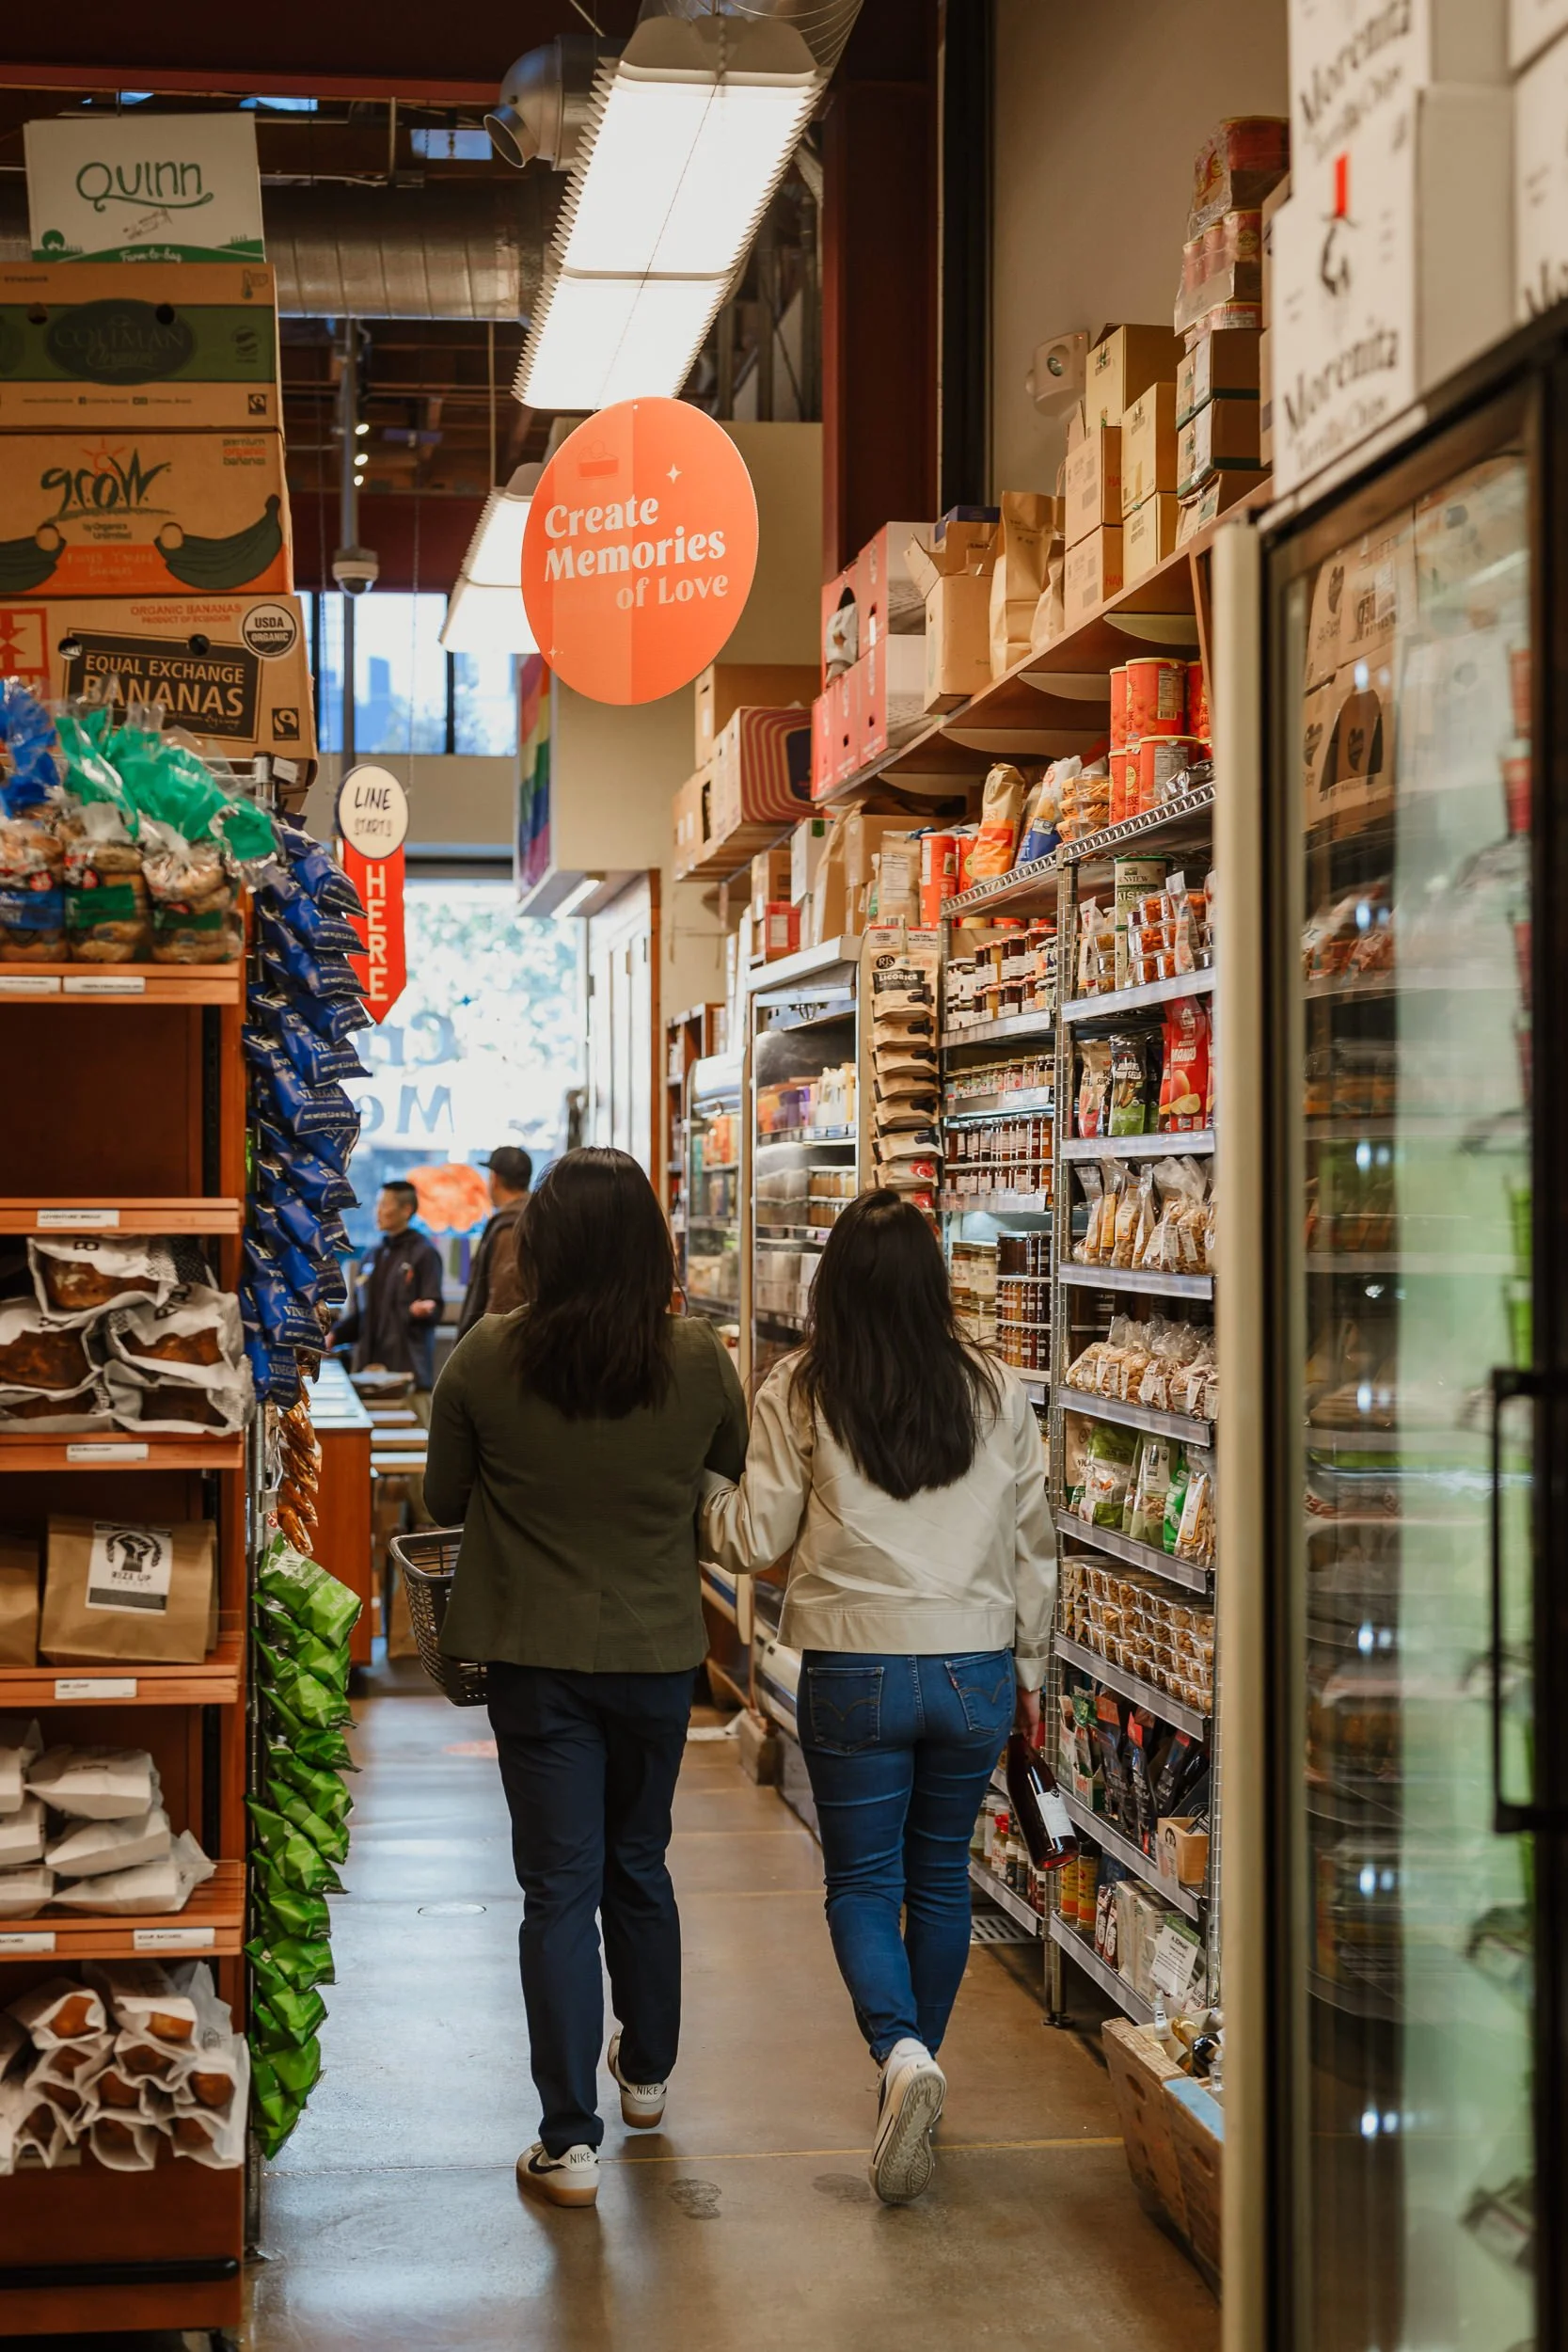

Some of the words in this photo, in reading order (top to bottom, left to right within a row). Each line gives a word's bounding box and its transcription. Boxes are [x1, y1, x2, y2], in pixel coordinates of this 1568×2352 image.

[545, 494, 659, 539] Create
[544, 526, 726, 582] Memories
[616, 577, 650, 610] of
[658, 574, 729, 605] Love
[131, 605, 183, 616] ORGANIC
[186, 603, 243, 613] BANANAS
[254, 616, 285, 629] USDA
[250, 632, 290, 643] ORGANIC
[85, 654, 144, 677] EQUAL
[148, 659, 245, 686] EXCHANGE
[83, 675, 245, 717] BANANAS
[355, 787, 391, 810] LINE
[365, 865, 389, 1001] HERE
[879, 973, 918, 981] LICORICE
[637, 2085, 658, 2095] NIKE
[570, 2152, 591, 2164] NIKE
